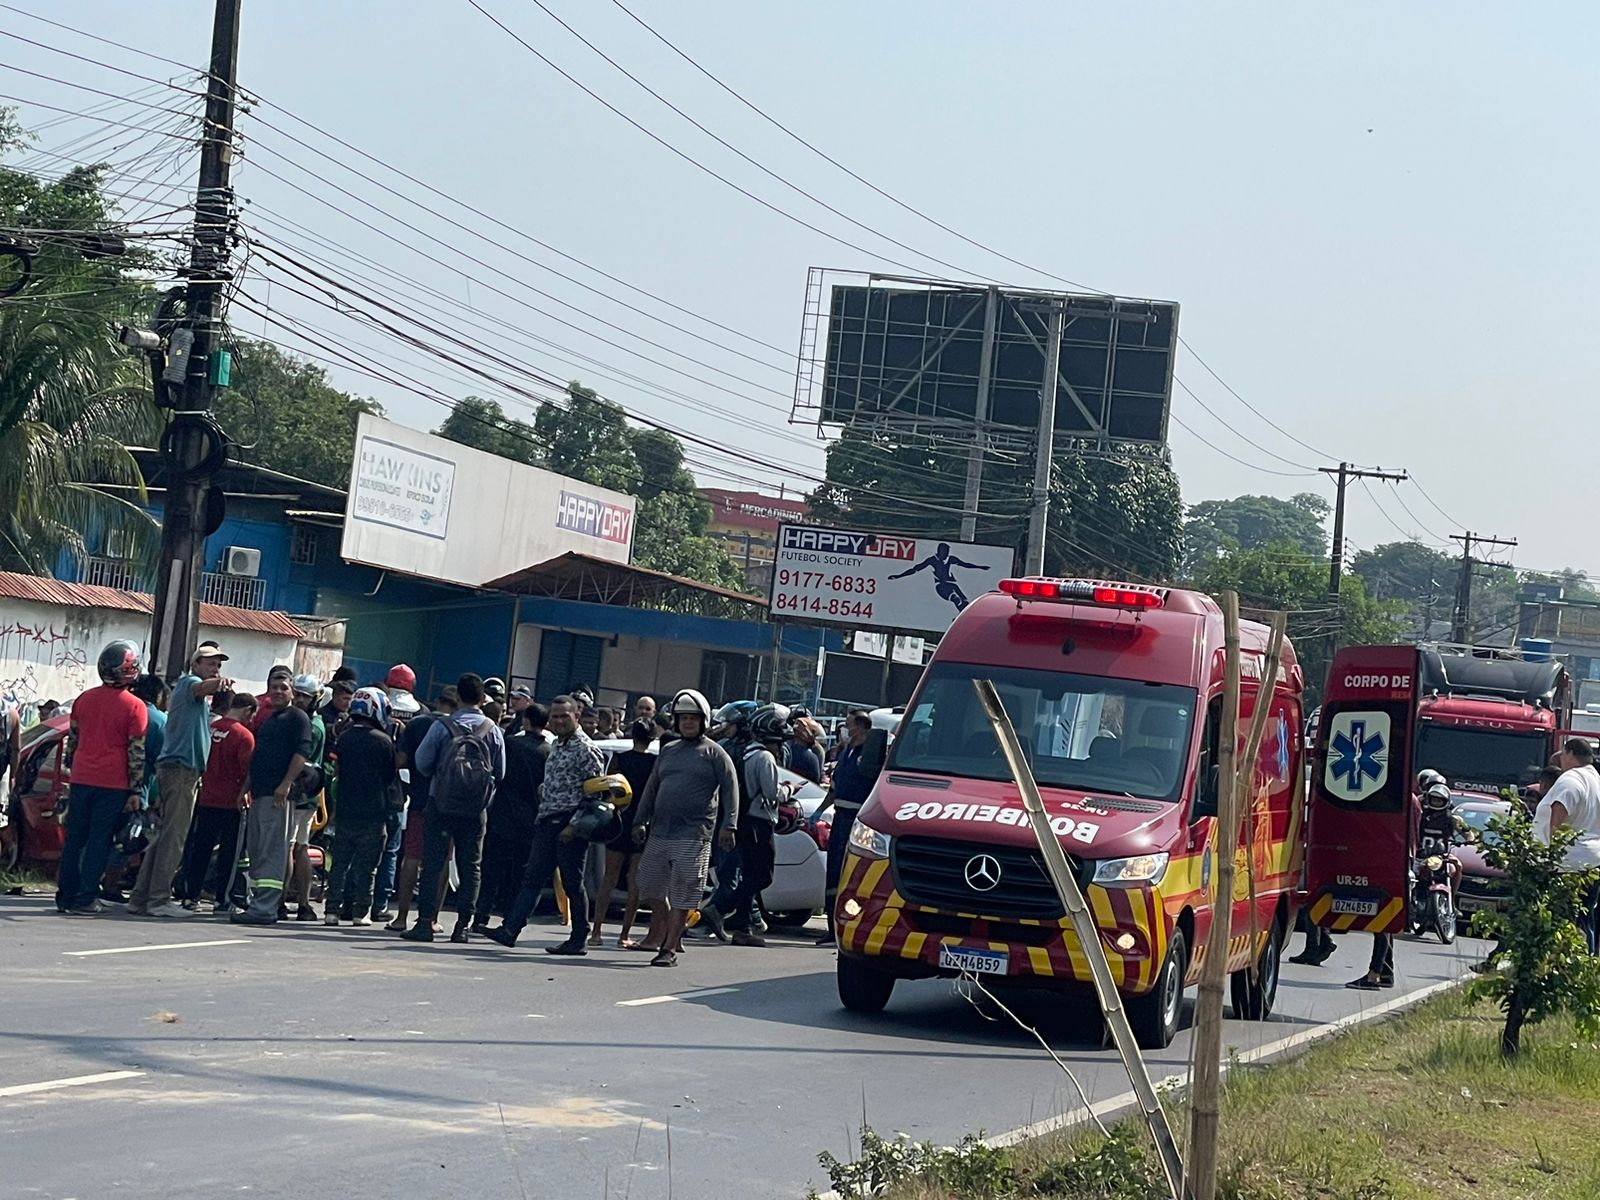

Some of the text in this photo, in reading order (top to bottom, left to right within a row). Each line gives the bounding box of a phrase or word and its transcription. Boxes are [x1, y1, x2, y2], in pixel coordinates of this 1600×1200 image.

[557, 494, 630, 540] HAPPY DAY
[784, 529, 864, 553] HAPPY
[781, 551, 863, 567] FUTEBOL SOCIETY
[779, 569, 877, 595] 9177-6833
[776, 593, 873, 618] 8414-8544
[1344, 675, 1411, 688] CORPO DE
[1454, 781, 1500, 794] SCANIA
[1336, 875, 1369, 887] UR-26
